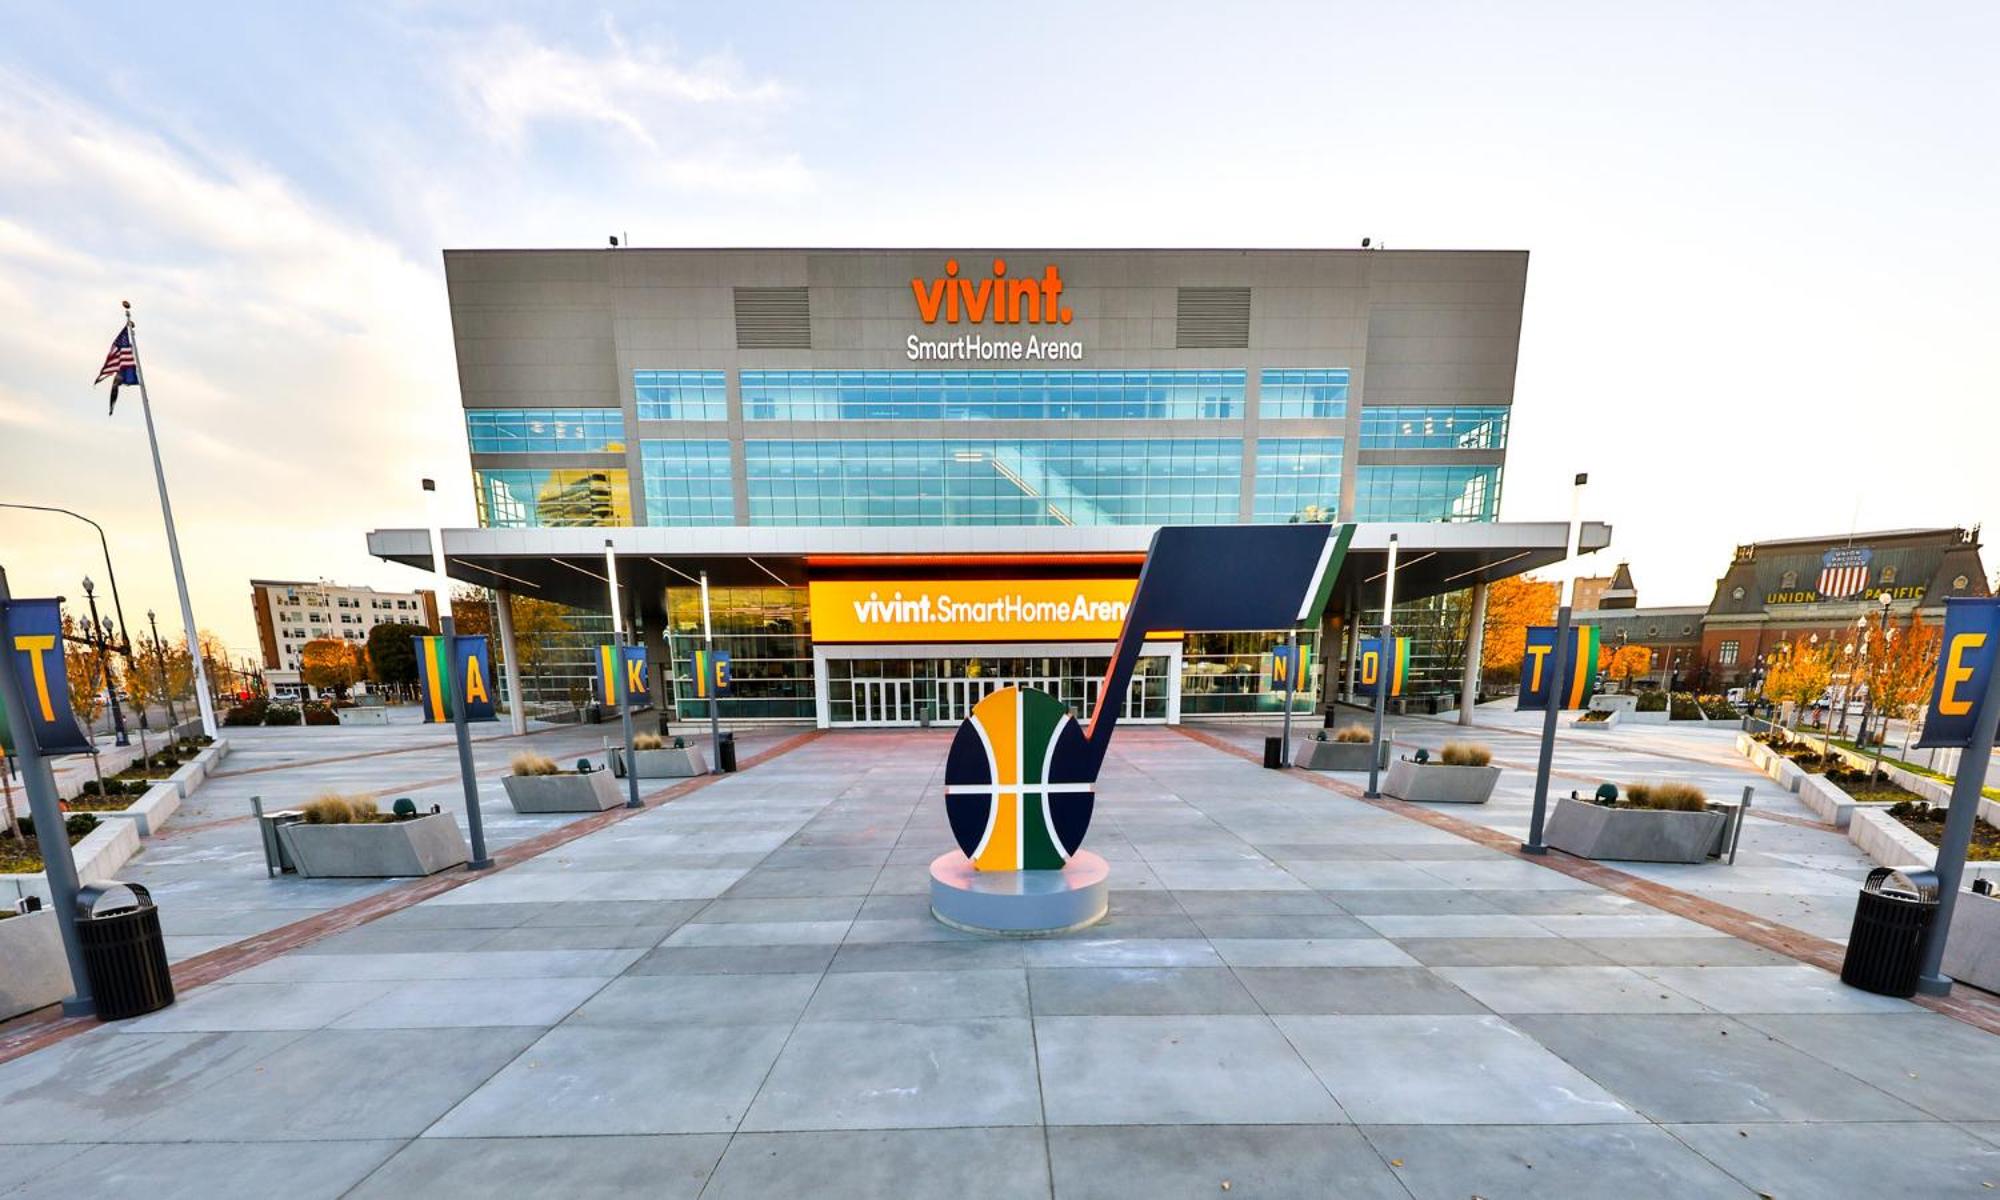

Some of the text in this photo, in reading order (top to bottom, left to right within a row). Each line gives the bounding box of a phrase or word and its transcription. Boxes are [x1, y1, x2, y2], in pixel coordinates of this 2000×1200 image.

[911, 258, 1073, 324] vivint.
[906, 334, 1083, 360] SmartHome Arena
[1767, 591, 1816, 604] UNION
[14, 635, 56, 722] T
[467, 655, 489, 704] A
[627, 660, 646, 693] K
[715, 661, 727, 688] E
[1273, 656, 1287, 682] N
[1527, 645, 1553, 693] T
[1938, 632, 1987, 716] E
